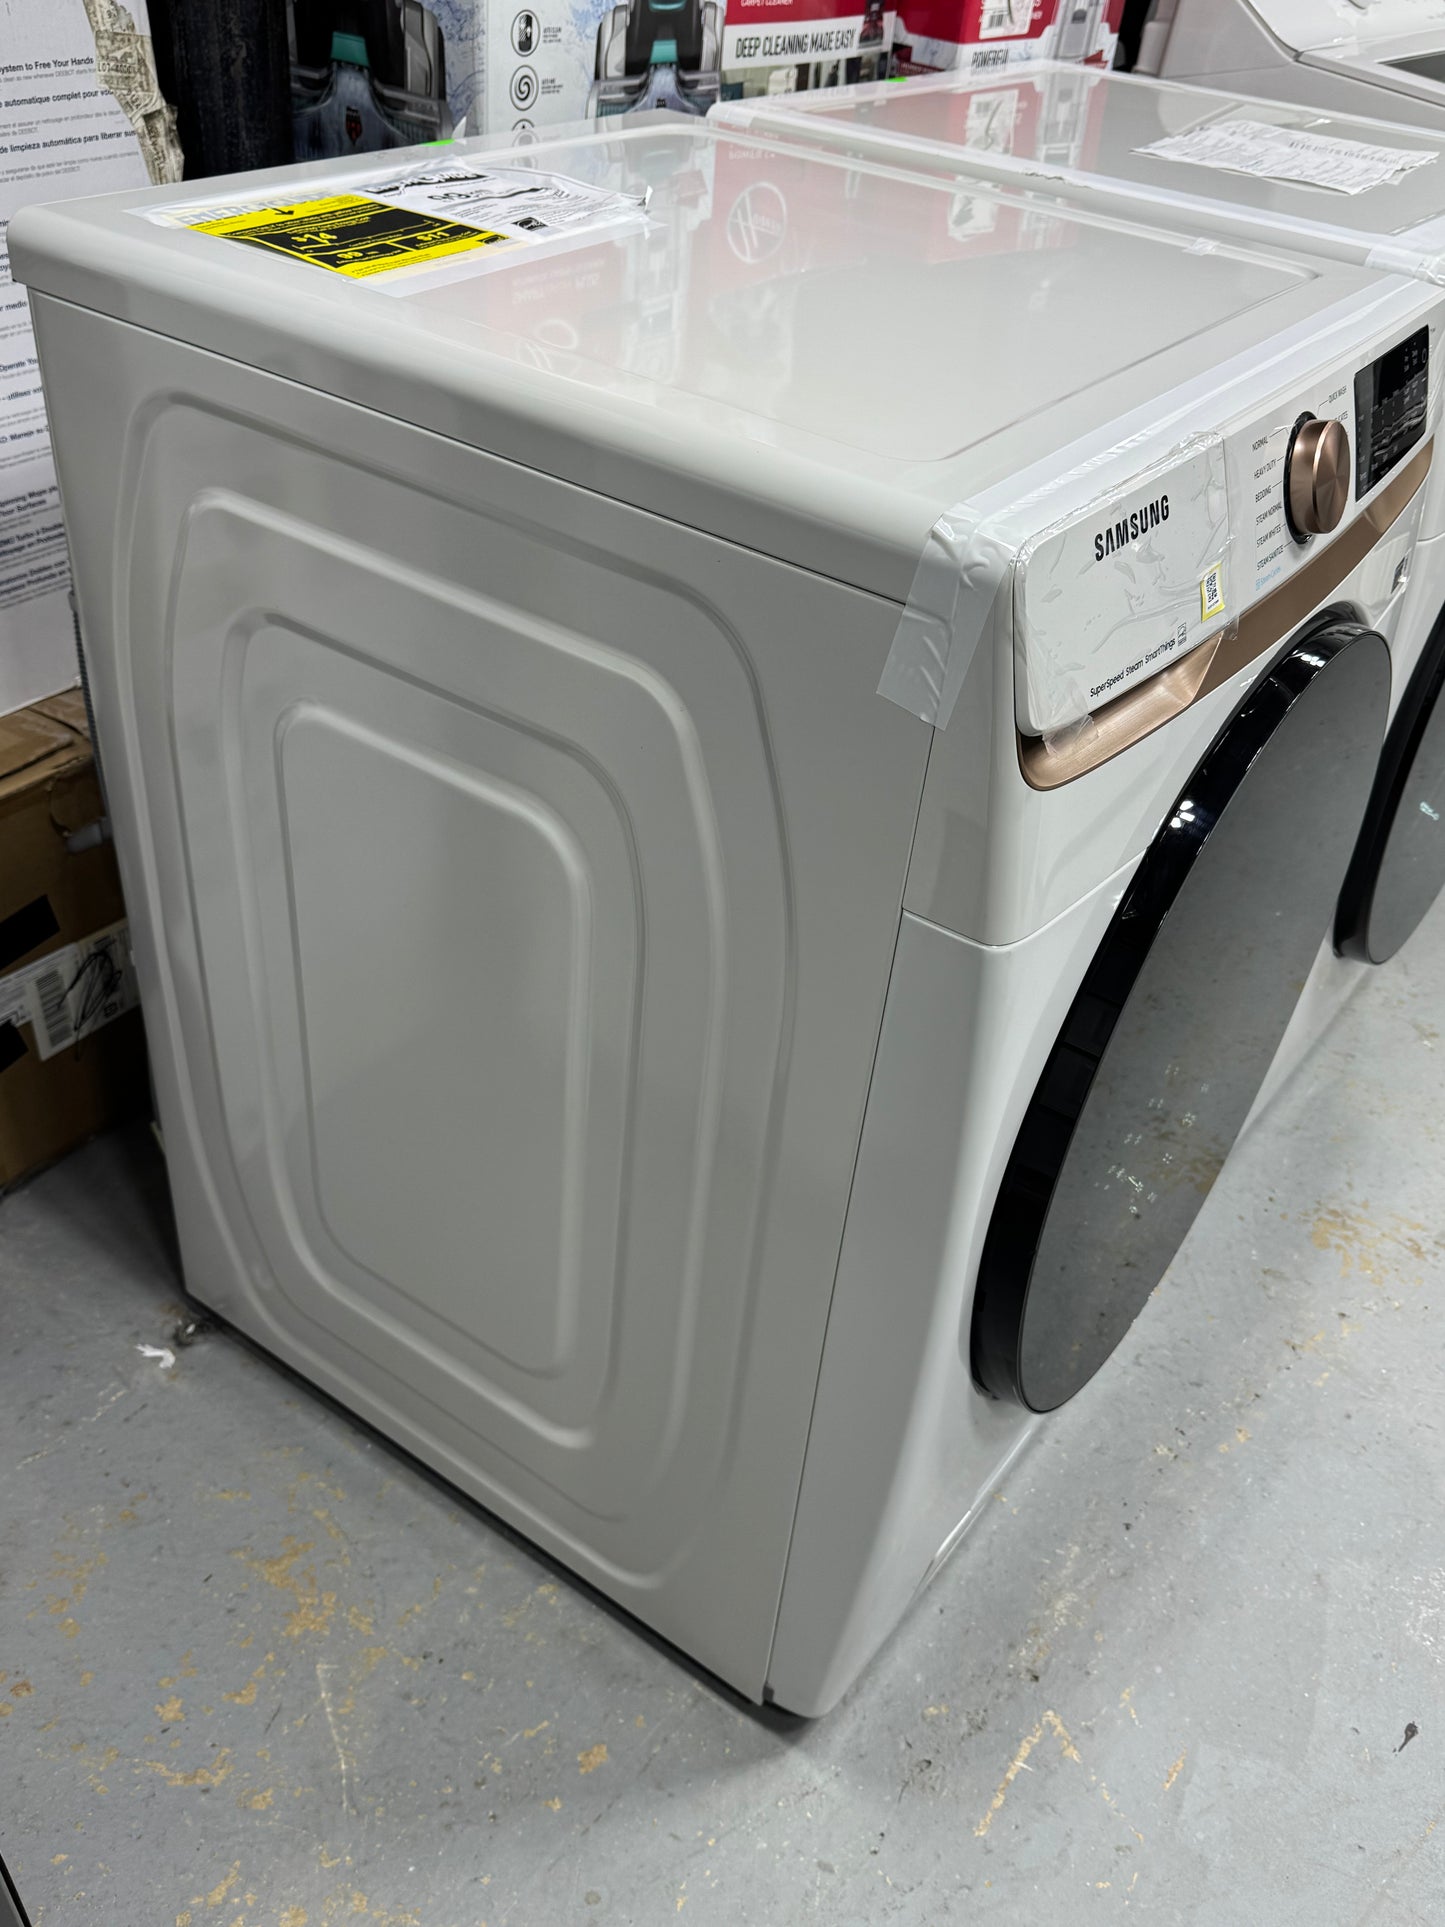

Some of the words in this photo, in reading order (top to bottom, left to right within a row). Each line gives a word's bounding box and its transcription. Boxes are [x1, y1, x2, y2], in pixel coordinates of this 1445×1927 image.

[735, 37, 760, 58] DEEP
[762, 34, 808, 56] CLEANING
[809, 31, 834, 53] MADE
[834, 29, 856, 49] EASY
[0, 63, 24, 75] ystem
[25, 63, 33, 71] to
[35, 61, 51, 70] Free
[52, 59, 69, 68] Your
[71, 56, 94, 66] Hands
[4, 95, 50, 107] automatique
[52, 91, 81, 102] complet
[82, 89, 98, 99] pour
[10, 142, 40, 153] limpieza
[83, 134, 99, 144] para
[101, 131, 122, 140] liberar
[1252, 436, 1268, 451] NORMAL
[1254, 465, 1267, 479] HEAVY
[1266, 459, 1277, 472] DUTY
[1255, 485, 1271, 503] BEDDING
[1256, 510, 1268, 526] STEAM
[1267, 501, 1282, 517] NORMAL
[1094, 494, 1170, 562] SAMSUNG
[1256, 532, 1269, 548] STEAM
[1268, 524, 1281, 539] WHITES
[1256, 556, 1269, 571] STEAM
[1268, 544, 1284, 560] SANITIZE
[1090, 669, 1125, 697] SuperSpeed
[1125, 659, 1144, 677] Steam
[1144, 638, 1176, 665] SmartThings
